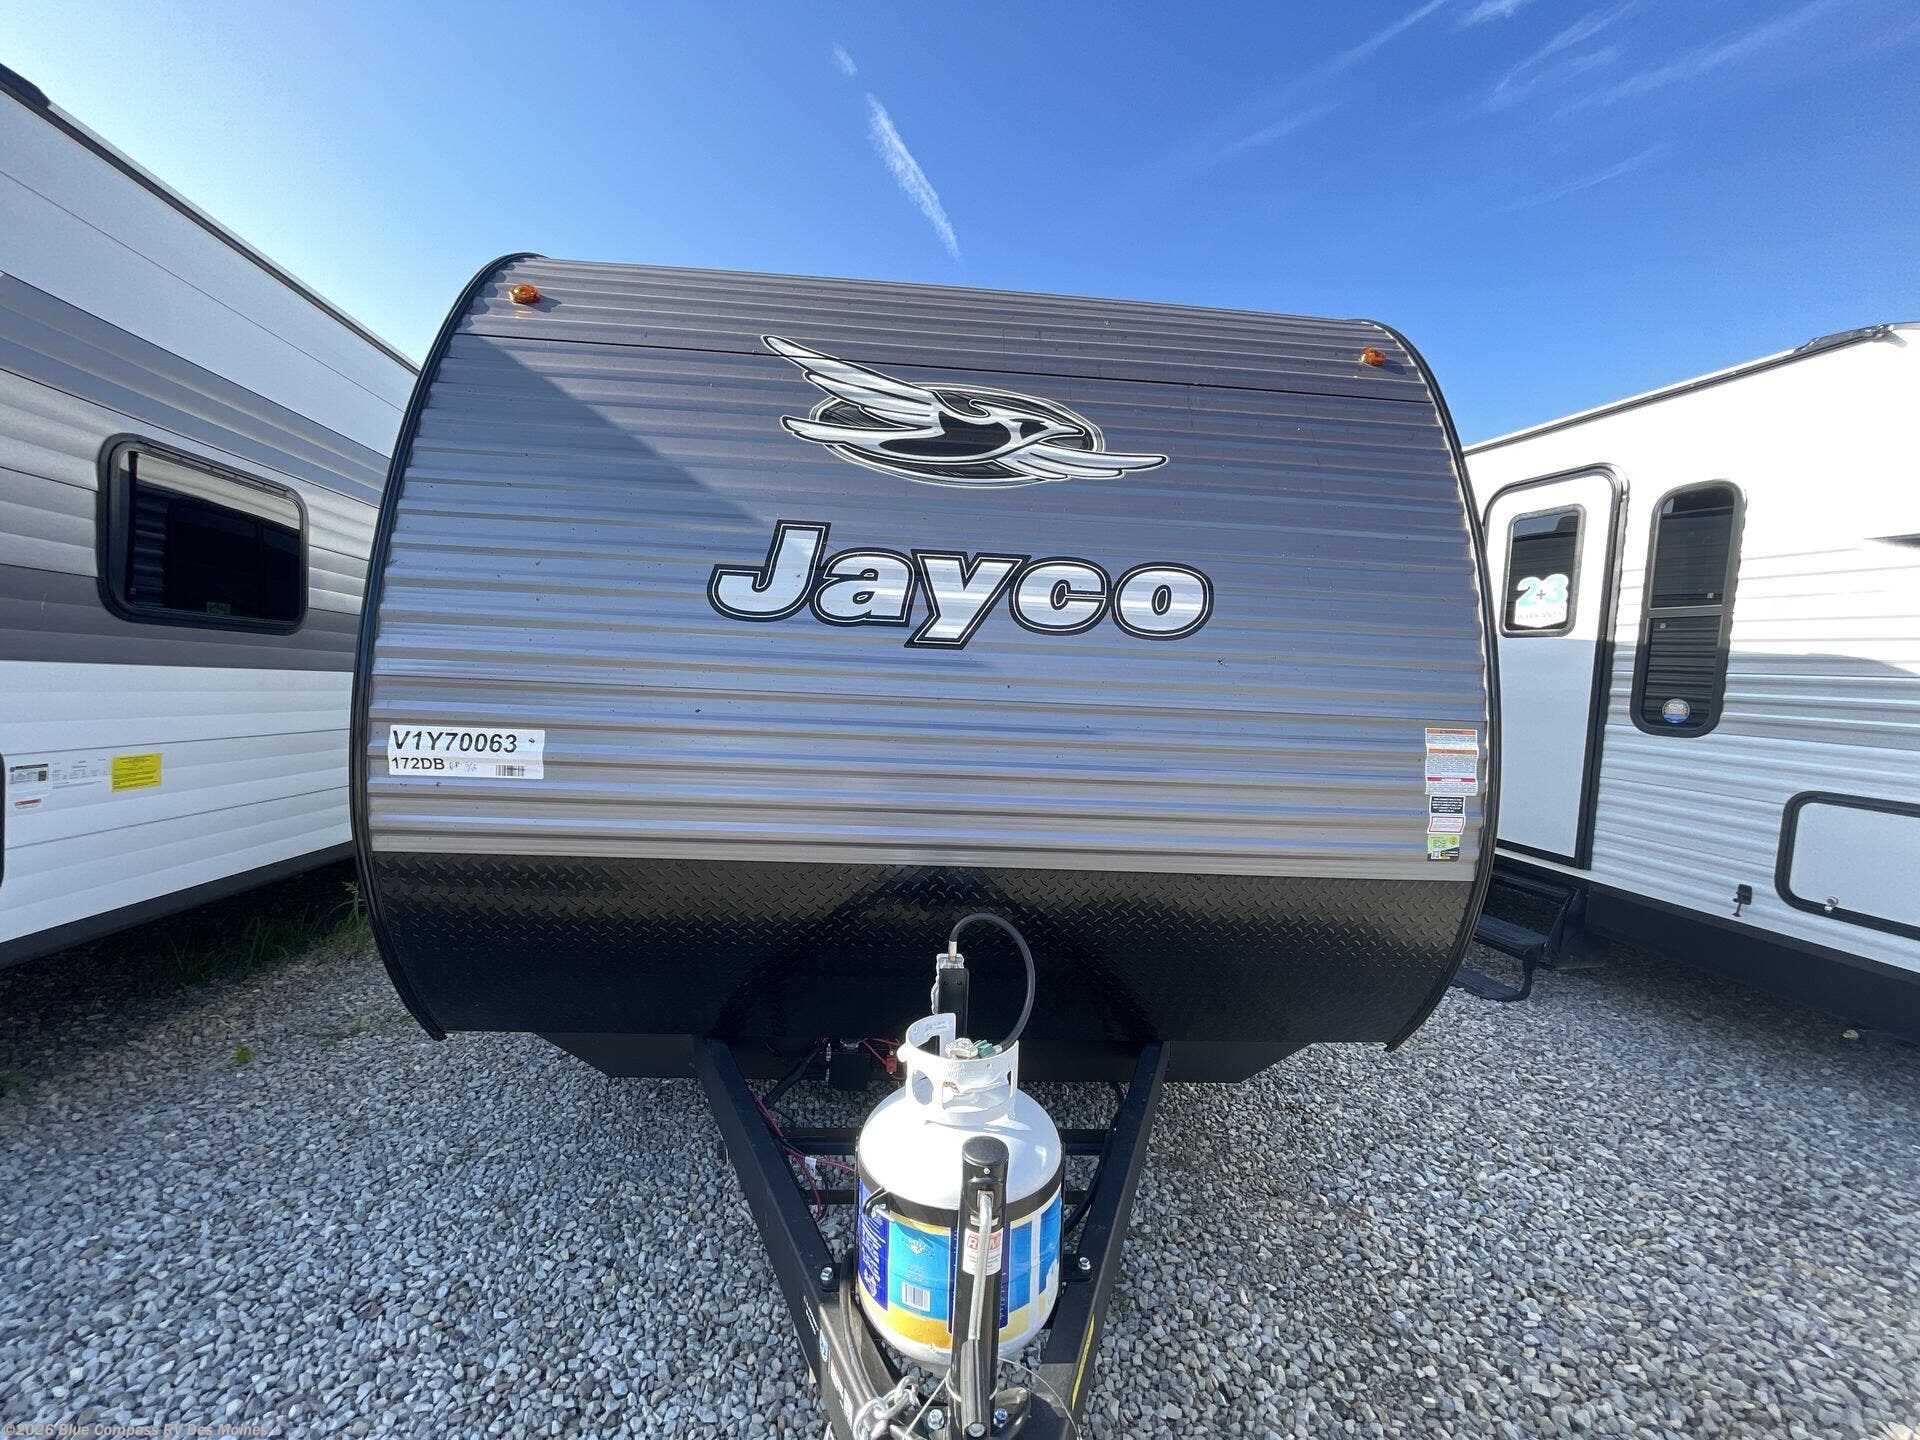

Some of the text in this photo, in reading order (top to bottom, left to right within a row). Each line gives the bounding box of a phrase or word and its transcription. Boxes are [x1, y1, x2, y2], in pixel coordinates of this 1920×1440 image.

[706, 519, 1215, 649] Jayco
[392, 730, 518, 754] V1Y70063
[391, 757, 445, 770] 172DB
[967, 1233, 1001, 1248] RM
